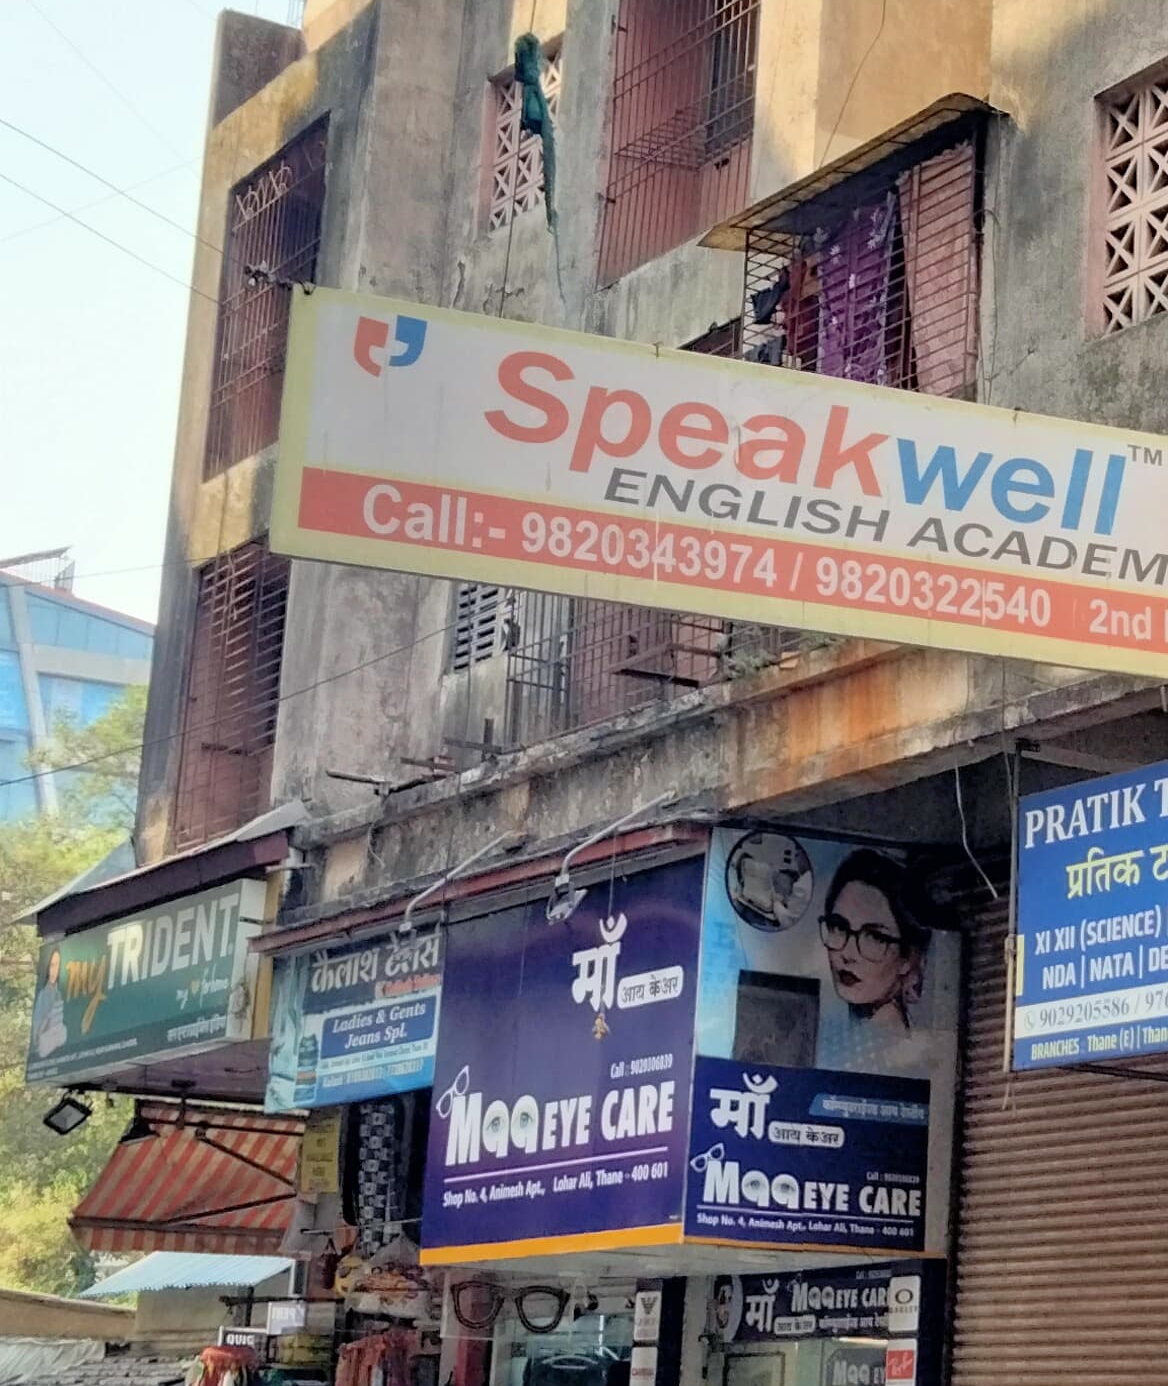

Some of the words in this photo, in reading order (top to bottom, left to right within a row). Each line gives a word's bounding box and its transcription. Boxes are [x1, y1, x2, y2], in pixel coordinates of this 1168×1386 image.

[604, 469, 890, 543] ENGLISH
[361, 481, 506, 551] Call:-
[521, 509, 776, 589] 9820343974
[816, 556, 1052, 628] 9820322540
[1088, 595, 1155, 641] 2nd
[1024, 783, 1147, 848] PRATIK
[1065, 847, 1145, 900] प्रतिक
[1034, 930, 1052, 956] XI
[1054, 926, 1076, 952] XII
[1080, 904, 1162, 951] (SCIENCE)
[66, 955, 107, 1036] my
[107, 892, 239, 990] TRIDENT
[311, 949, 380, 993] कैलाश
[1042, 962, 1077, 990] NDA
[1090, 952, 1134, 983] NATA
[332, 1012, 373, 1034] Ladies
[375, 1009, 385, 1023] &
[389, 1002, 426, 1021] Gents
[1039, 997, 1130, 1028] 9029205586
[344, 1029, 380, 1049] Jeans
[383, 1022, 408, 1044] Spl.
[1087, 1031, 1118, 1052] Thane
[1119, 1028, 1134, 1050] (E)
[542, 1095, 592, 1150] EYE
[601, 1080, 675, 1141] CARE
[443, 1190, 463, 1209] Shop
[465, 1188, 479, 1204] No.
[489, 1181, 524, 1201] Animesh
[553, 1175, 577, 1192] Lohar
[579, 1172, 593, 1190] Ali,
[596, 1169, 623, 1187] Thane
[631, 1164, 649, 1181] 400
[651, 1162, 668, 1179] 601
[803, 1181, 849, 1212] EYE
[859, 1186, 922, 1217] CARE
[697, 1213, 719, 1226] Shop
[721, 1213, 736, 1225] No.
[749, 1217, 785, 1230] Animesh
[808, 1220, 832, 1232] Lohar
[834, 1222, 849, 1235] Ali,
[850, 1224, 875, 1235] Thane
[882, 1226, 898, 1236] 400
[836, 1288, 858, 1309] EYE
